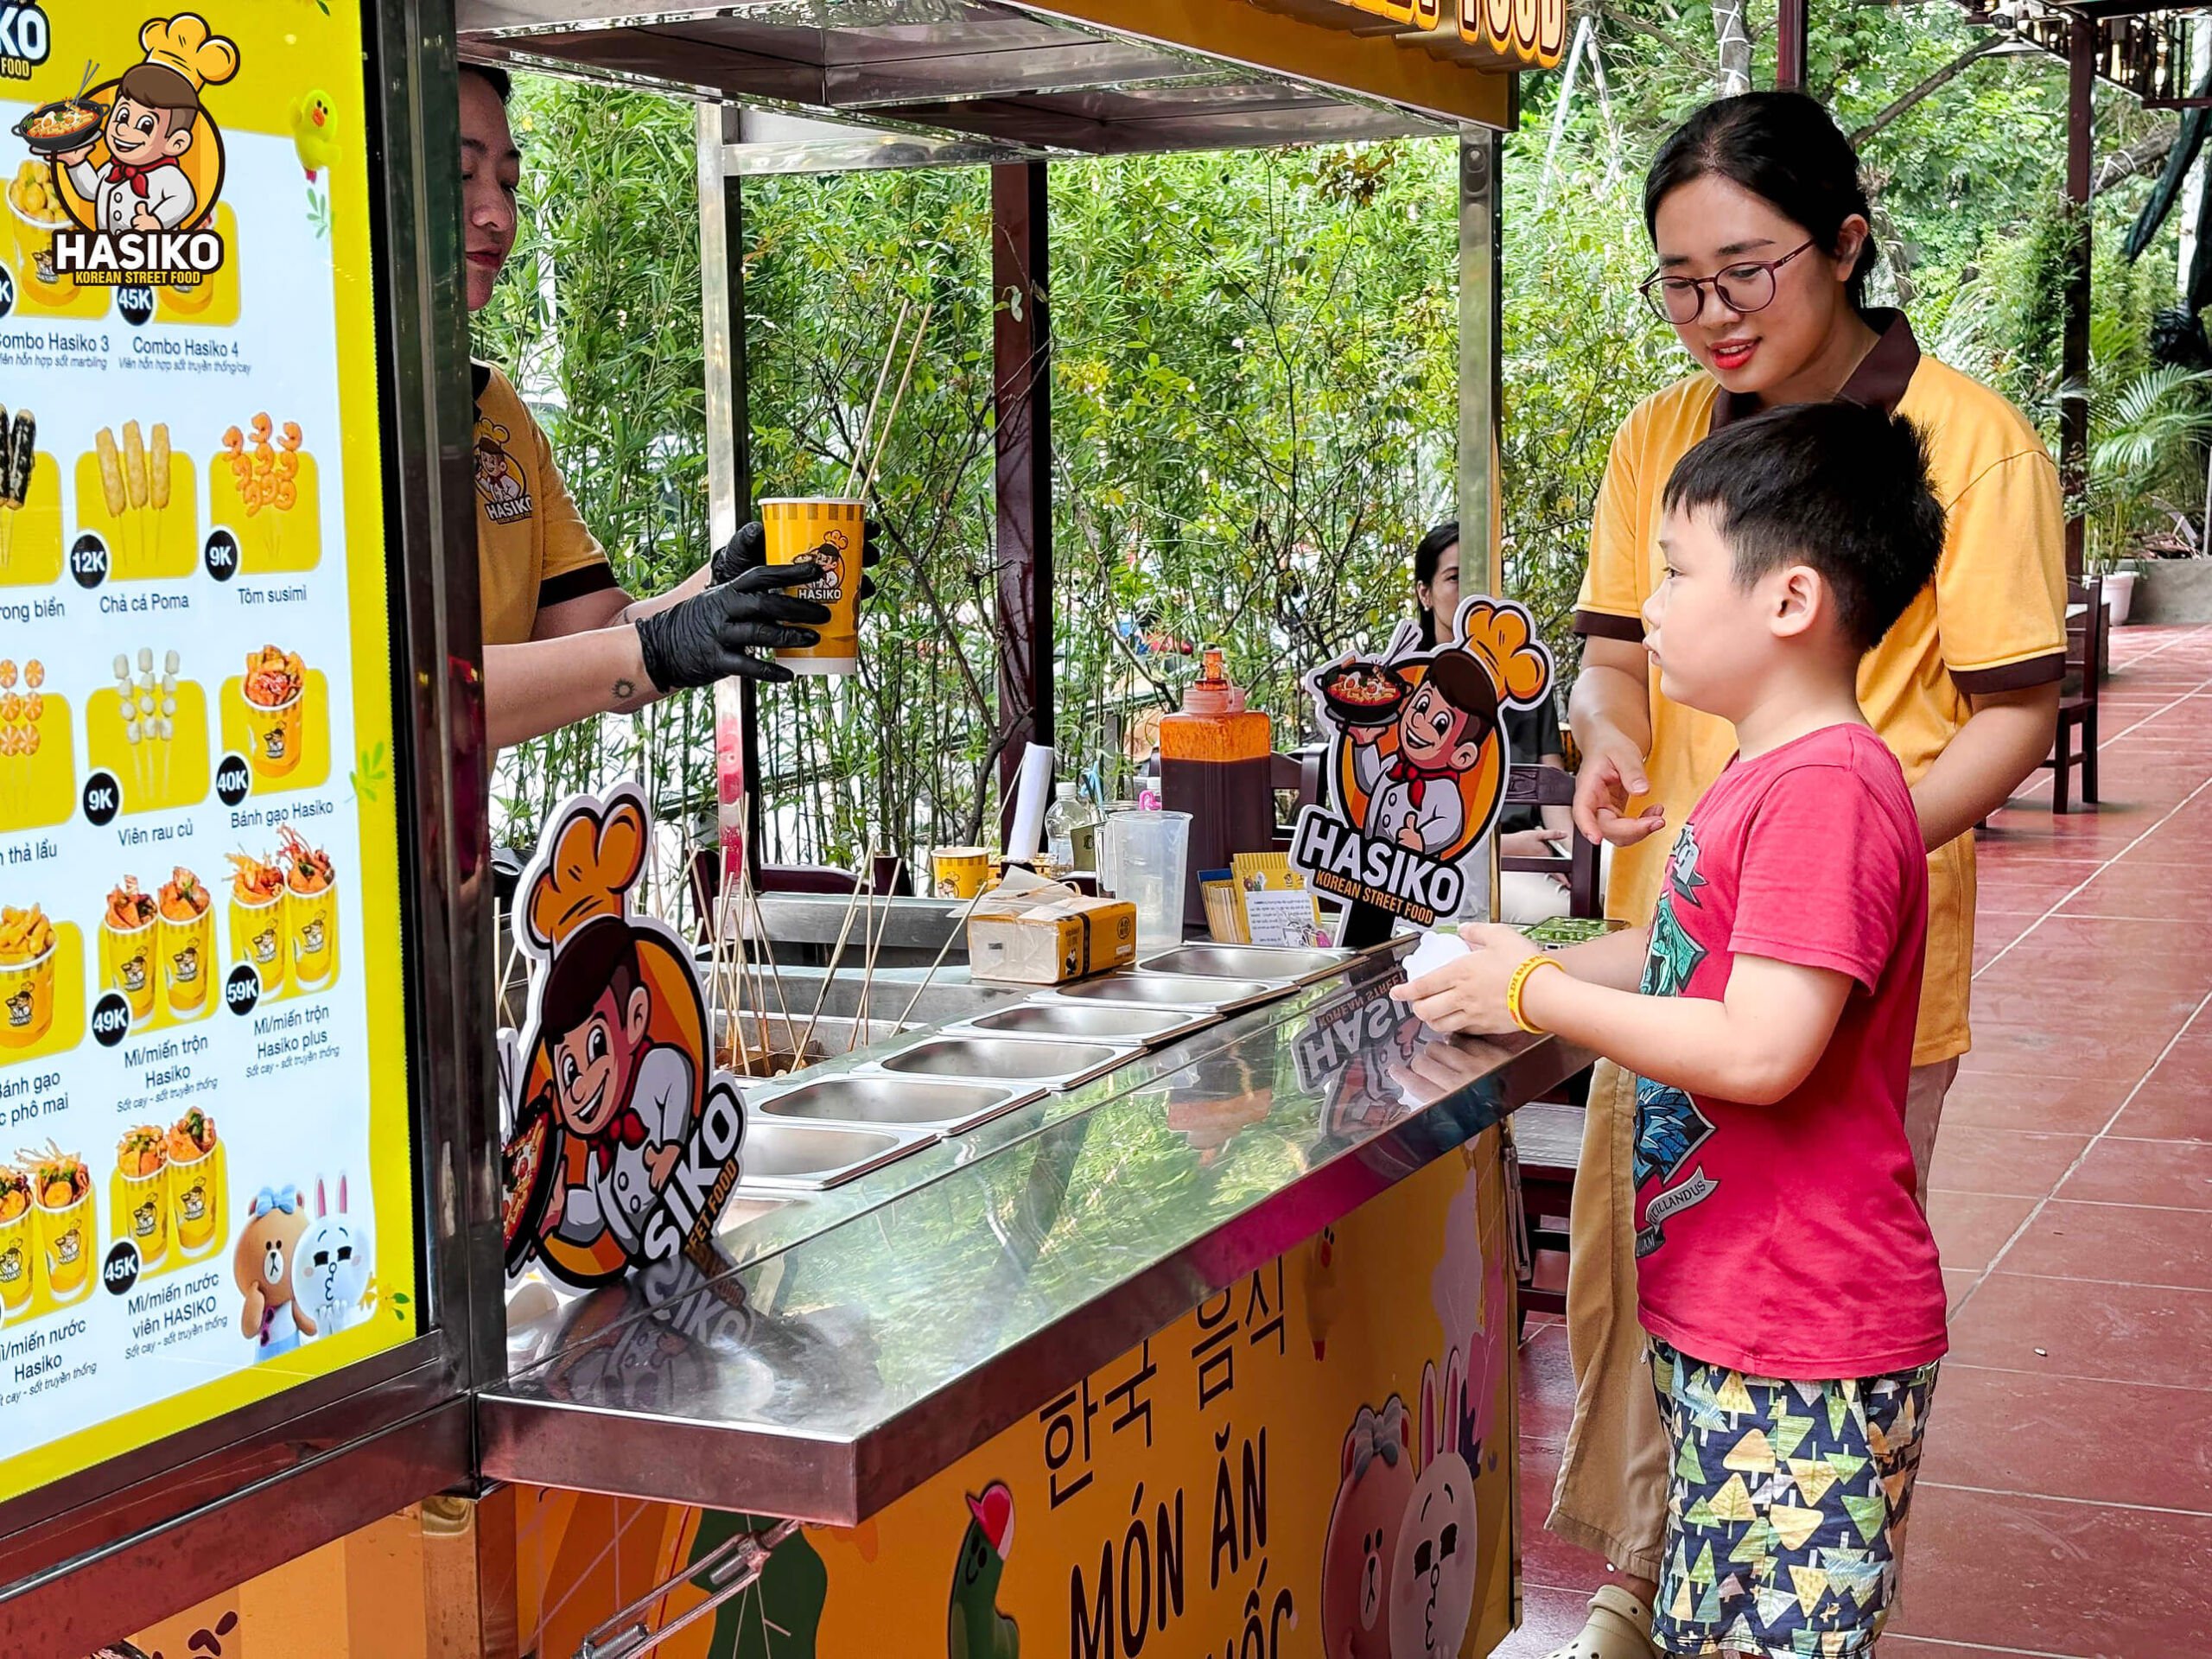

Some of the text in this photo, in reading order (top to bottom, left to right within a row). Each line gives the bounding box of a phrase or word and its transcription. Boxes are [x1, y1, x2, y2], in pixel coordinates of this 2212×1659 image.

[1, 58, 29, 77] FOOD
[119, 289, 151, 309] 45K
[48, 332, 97, 352] Hasiko
[101, 335, 110, 353] 3
[133, 336, 238, 357] Combo Hasiko 4
[72, 551, 105, 572] 12K
[209, 546, 232, 567] 9K
[34, 595, 65, 617] biển
[99, 594, 189, 613] Chả cá Poma
[238, 588, 264, 604] Tôm
[799, 589, 841, 599] HASIKO
[218, 772, 247, 791] 40K
[89, 788, 113, 810] 9K
[232, 799, 334, 828] Bánh gạo Hasiko
[118, 818, 193, 846] Viên rau củ
[8, 842, 32, 864] thả
[36, 838, 57, 860] lẩu
[1302, 818, 1459, 912] HASIKO
[1316, 870, 1434, 925] KOREAN STREET FOOD
[227, 977, 257, 1001] 59K
[92, 1007, 127, 1033] 49K
[254, 1005, 329, 1036] Mì/miến trộn
[124, 1035, 207, 1068] Mì/miến trộn
[257, 1030, 327, 1059] Hasiko plus
[34, 1072, 60, 1094] gạo
[145, 1065, 190, 1089] Hasiko
[11, 1100, 38, 1127] phô
[43, 1092, 68, 1115] mai
[707, 1159, 737, 1215] FOOD
[105, 1255, 137, 1281] 45K
[128, 1273, 219, 1316] Mì/miến nước
[132, 1296, 216, 1338] viên HASIKO
[0, 1319, 86, 1362] ì/miến nước
[15, 1354, 62, 1383] Hasiko
[1071, 1421, 1266, 1659] MÓN ĂN
